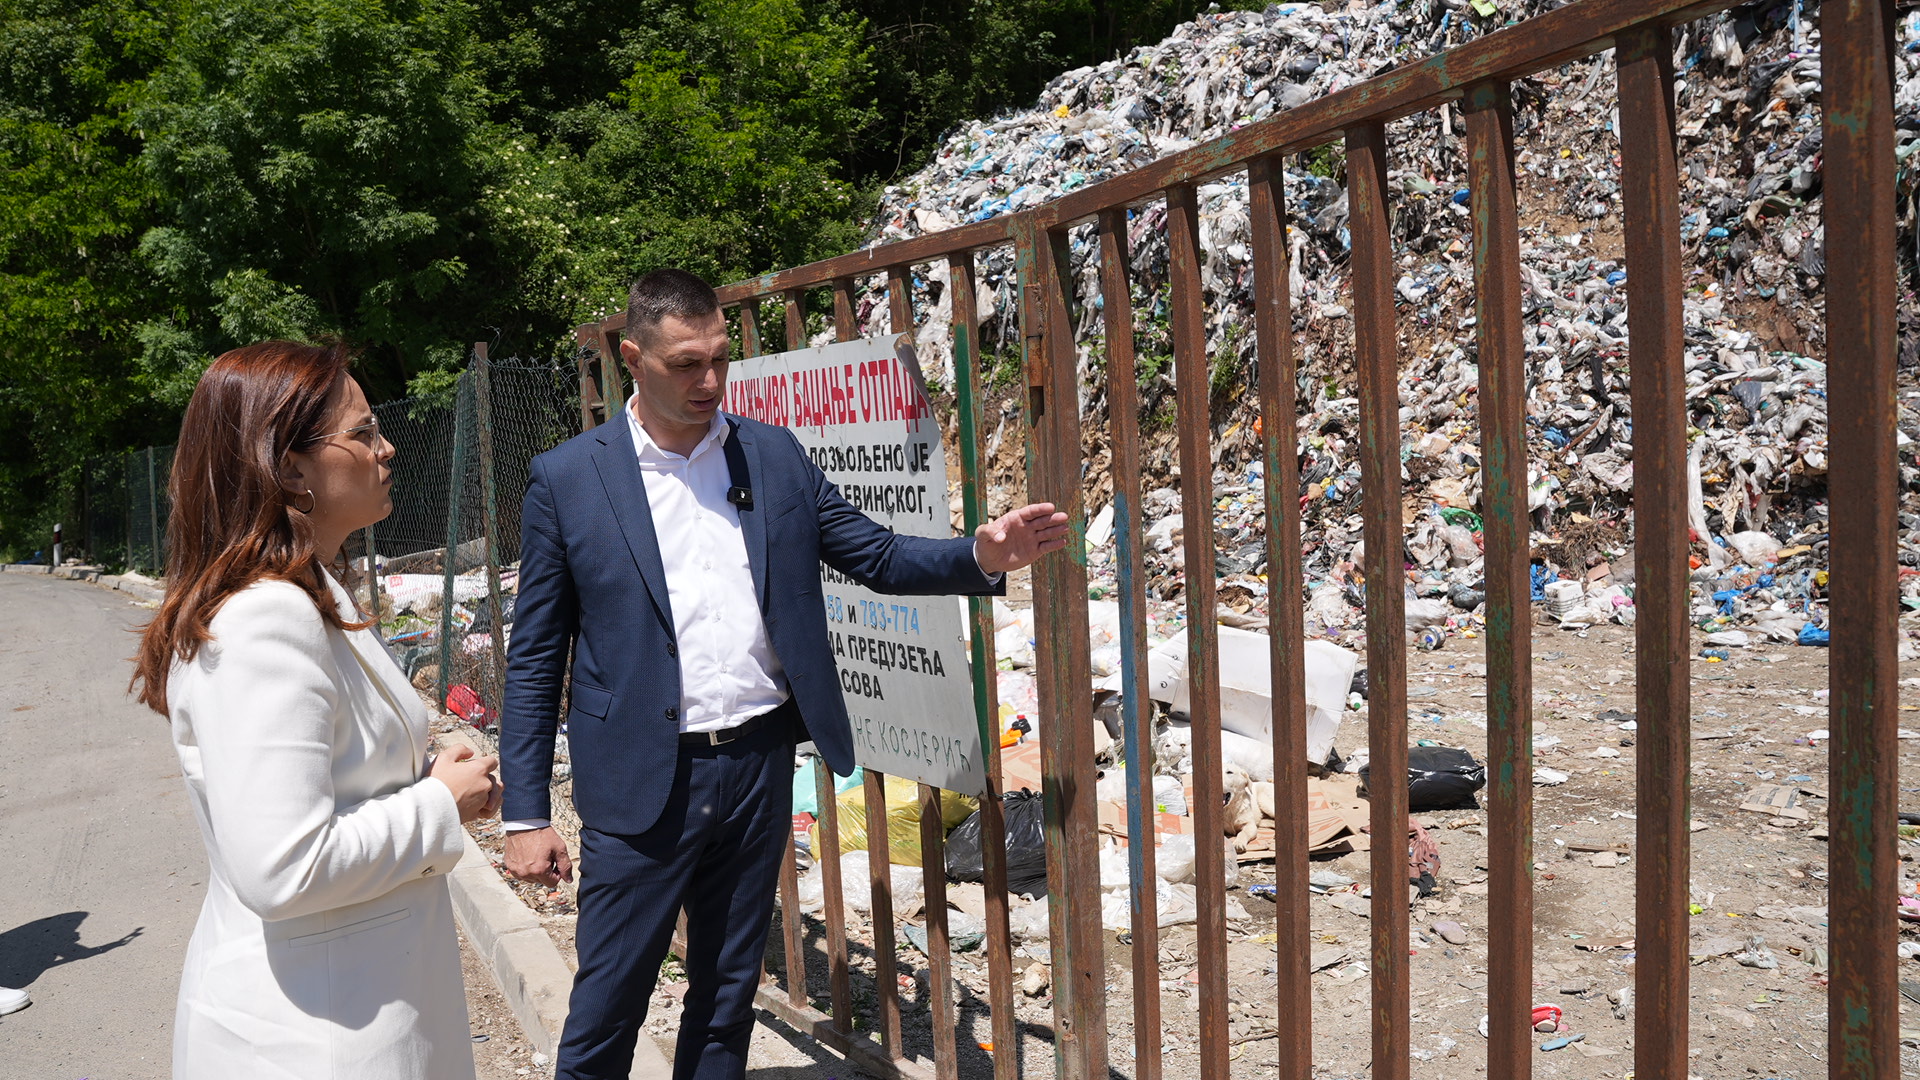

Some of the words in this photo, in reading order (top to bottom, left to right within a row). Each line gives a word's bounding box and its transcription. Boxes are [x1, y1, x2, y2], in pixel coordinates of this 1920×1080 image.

[792, 364, 857, 438] БАЦАЊЕ
[910, 442, 930, 472] ЈЕ
[834, 484, 933, 521] ЕВИНСКОГ,
[860, 599, 920, 635] 783-774
[848, 634, 946, 677] ПРЕДУЗЕЋА
[840, 668, 884, 700] СОВА
[878, 720, 971, 773] КОСЈЕРИЋ
